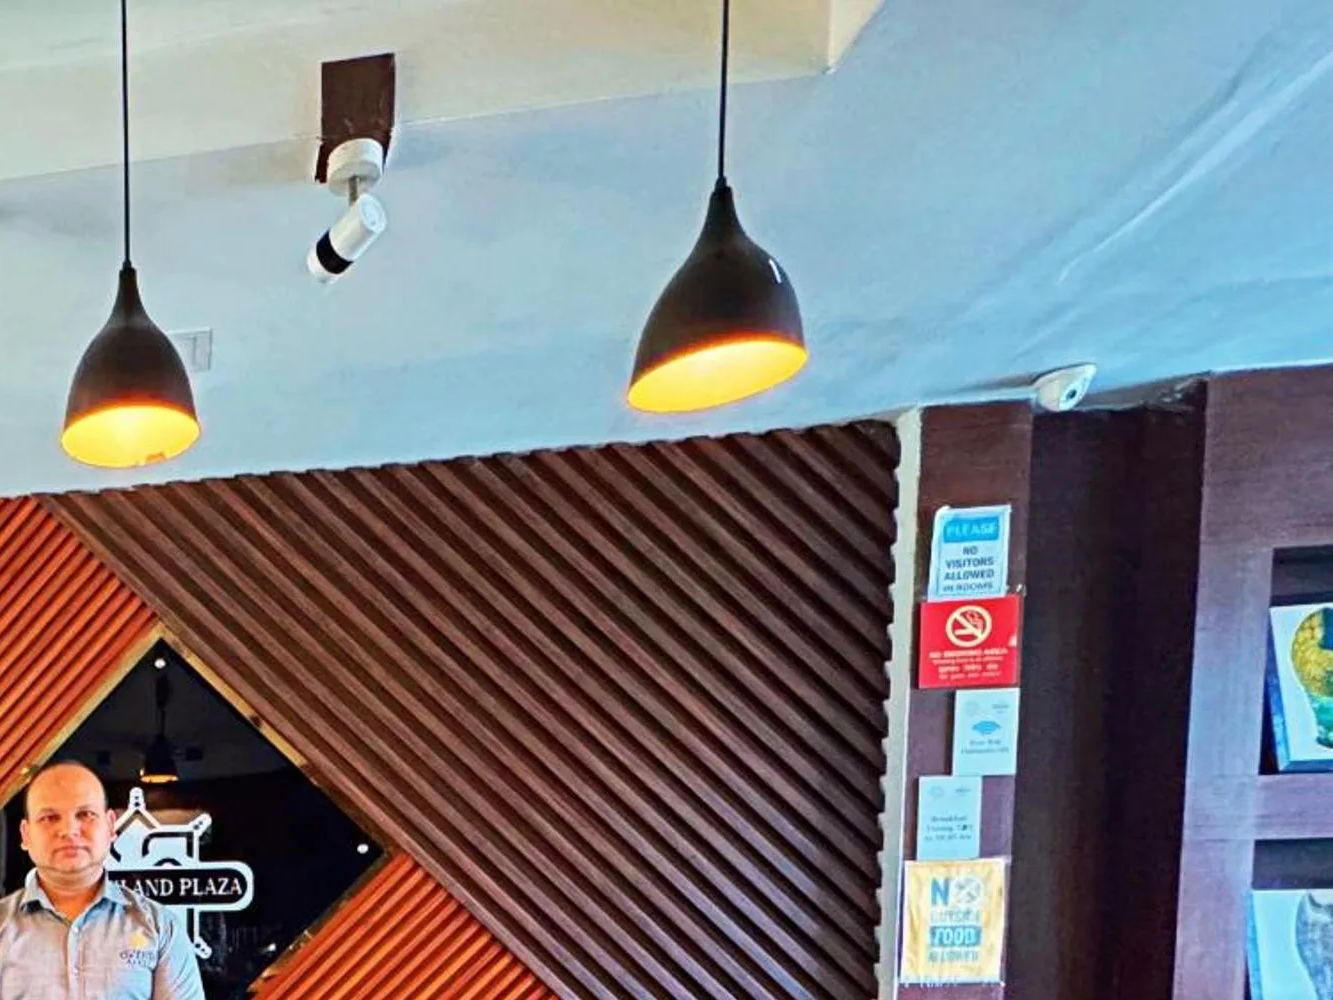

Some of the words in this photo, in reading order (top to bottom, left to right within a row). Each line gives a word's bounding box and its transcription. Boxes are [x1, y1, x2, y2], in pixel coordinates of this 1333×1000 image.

[947, 522, 997, 537] PLEASE
[962, 546, 978, 556] NO
[945, 556, 995, 569] VISITORS
[944, 569, 995, 582] ALLOWED
[179, 877, 243, 896] PLAZA
